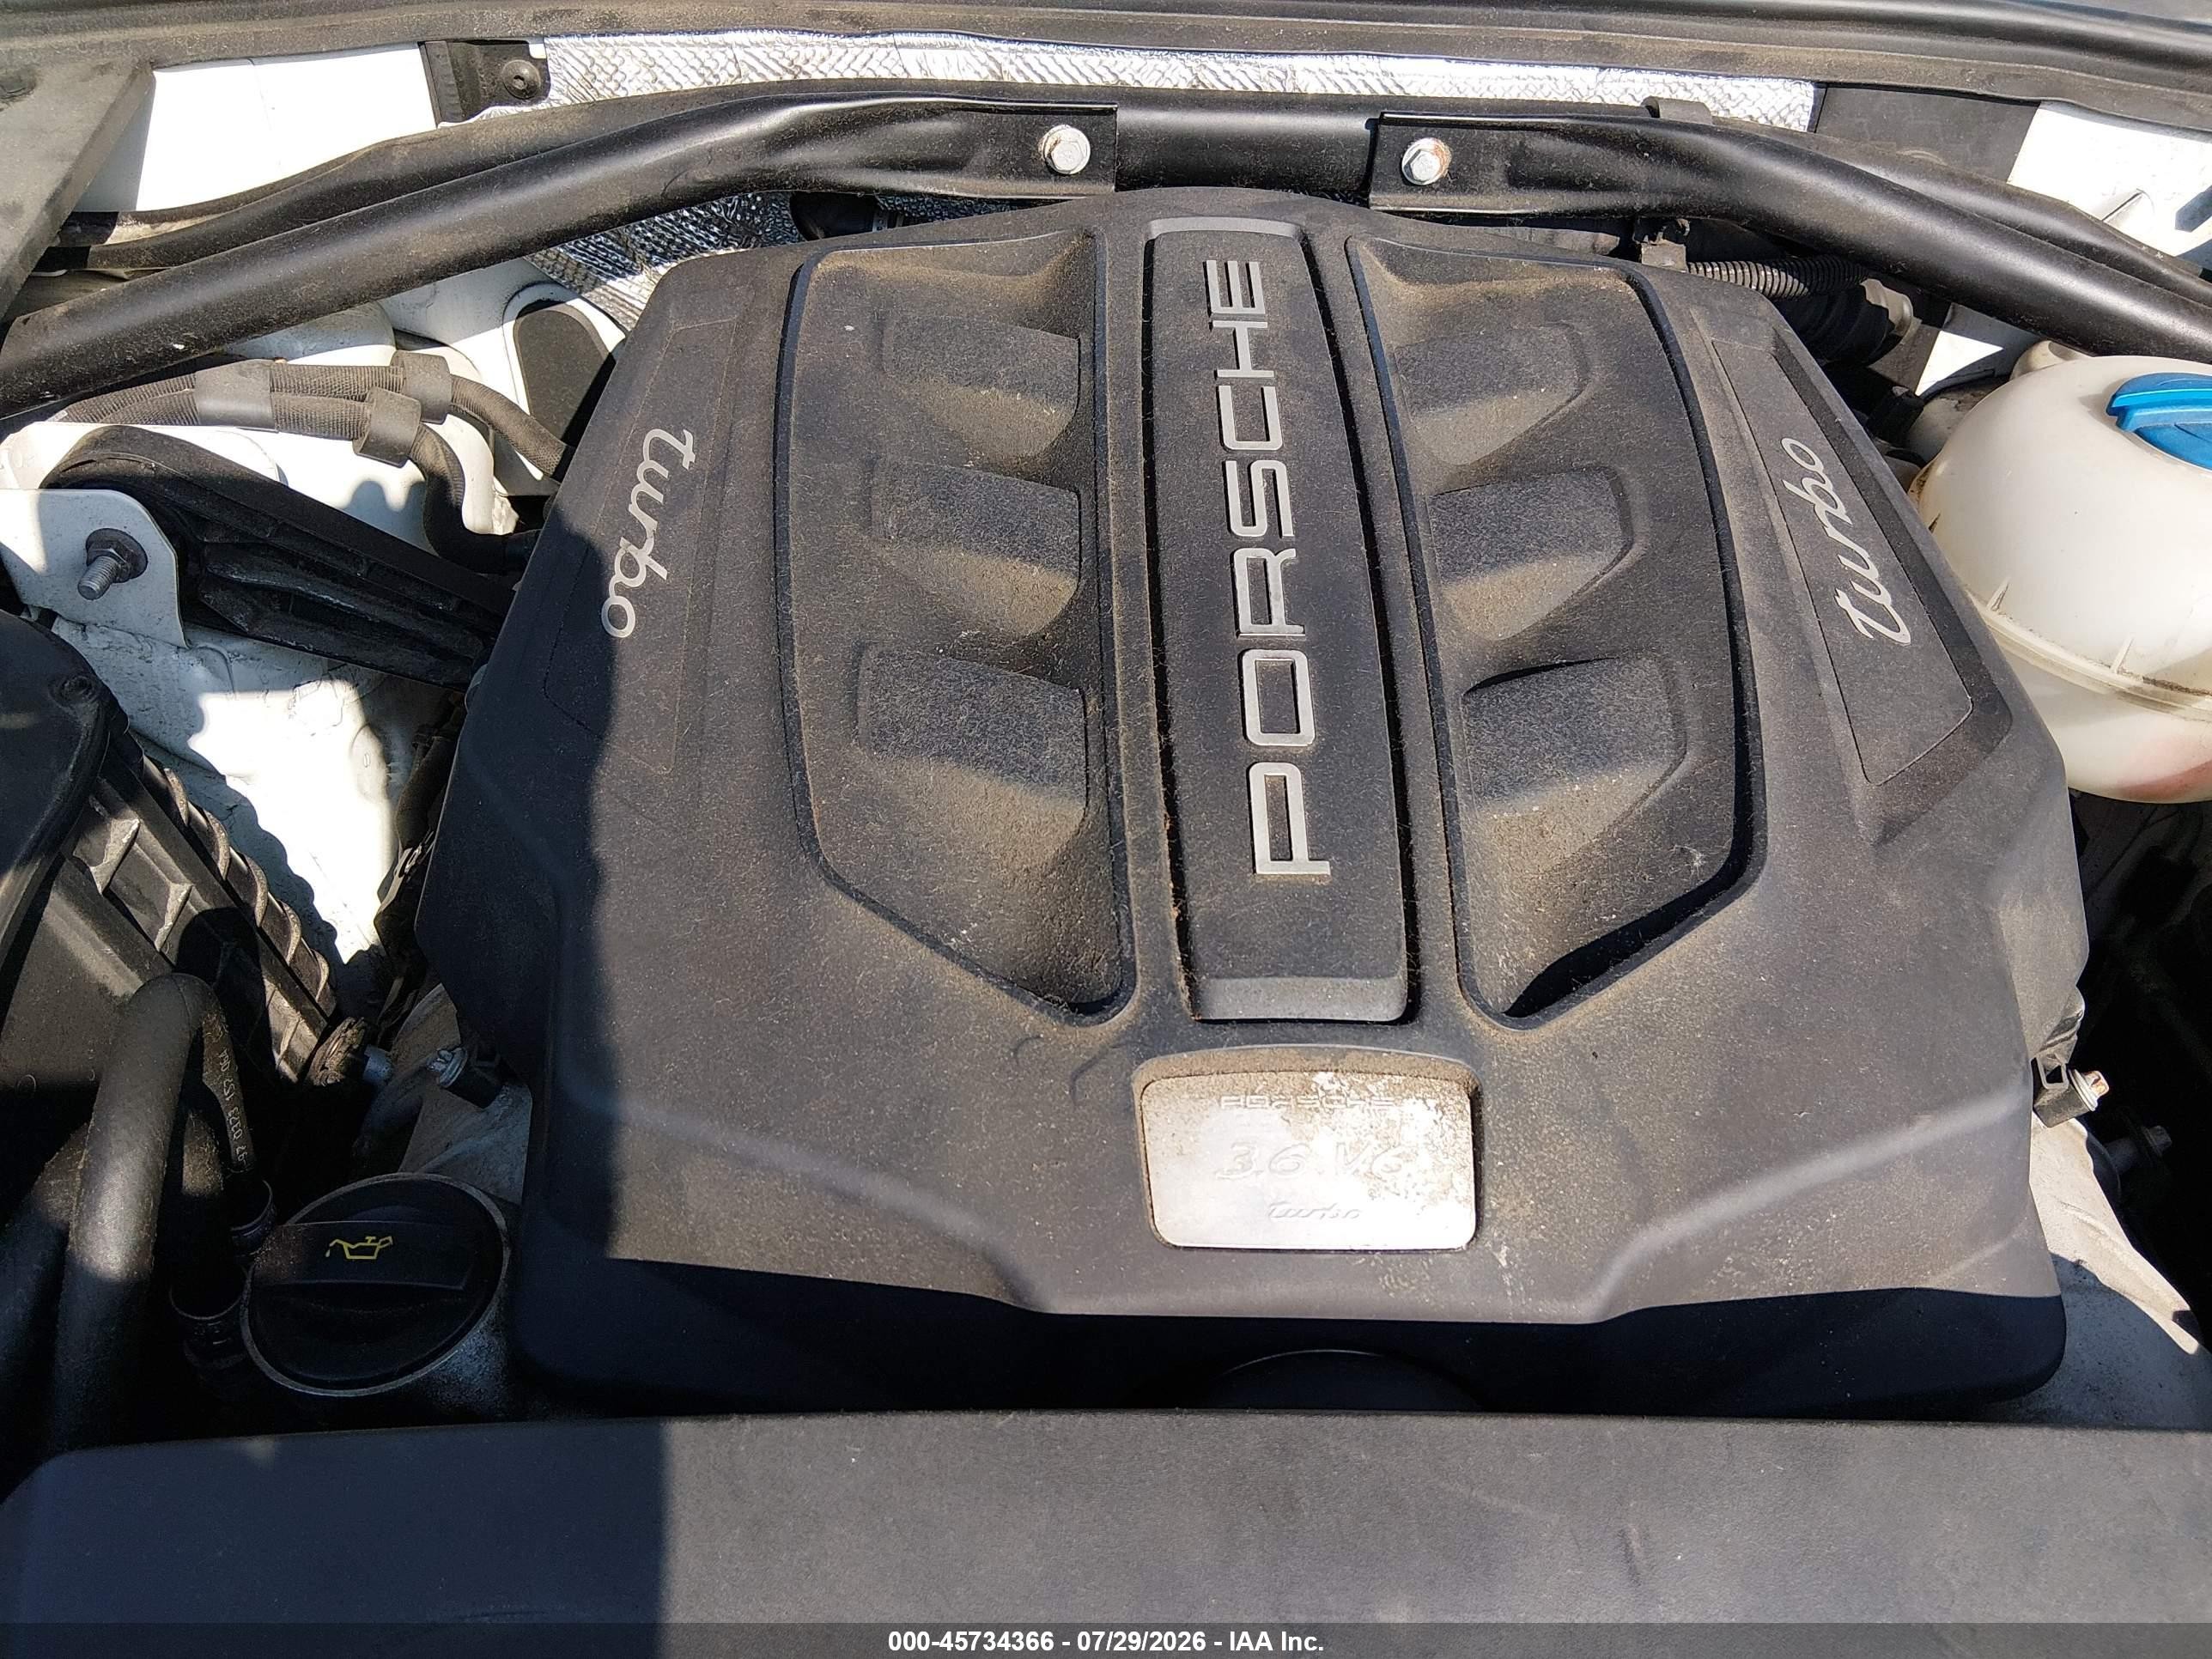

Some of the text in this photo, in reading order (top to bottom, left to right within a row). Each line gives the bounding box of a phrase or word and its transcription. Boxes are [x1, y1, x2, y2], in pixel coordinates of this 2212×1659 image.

[601, 428, 696, 638] turbo
[1206, 260, 1331, 876] PORSCHE
[1781, 437, 1911, 644] turbo
[1214, 1141, 1308, 1181] 3.6
[1267, 1201, 1363, 1220] turbo
